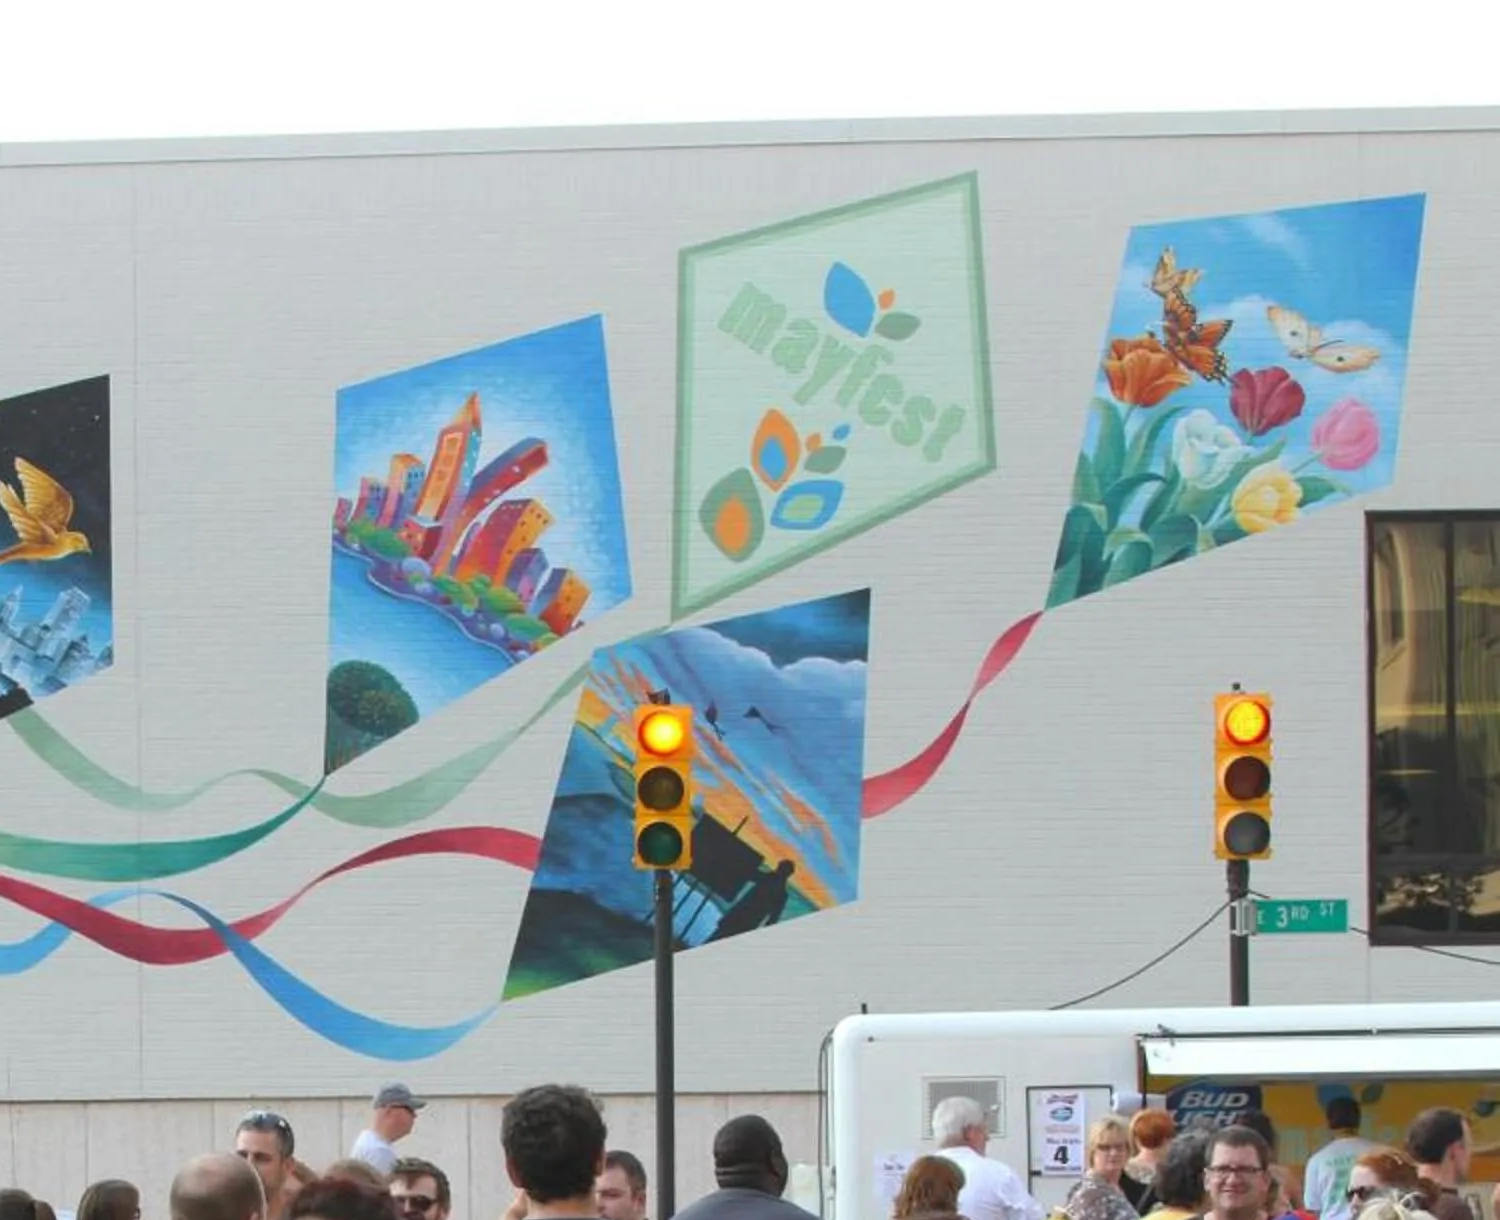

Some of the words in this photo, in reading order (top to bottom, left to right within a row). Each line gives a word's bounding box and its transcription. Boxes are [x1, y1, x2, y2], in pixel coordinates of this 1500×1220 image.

[716, 281, 967, 463] mayfest
[1320, 902, 1336, 917] ST
[1180, 1090, 1250, 1109] BUD
[1053, 1145, 1069, 1165] 4
